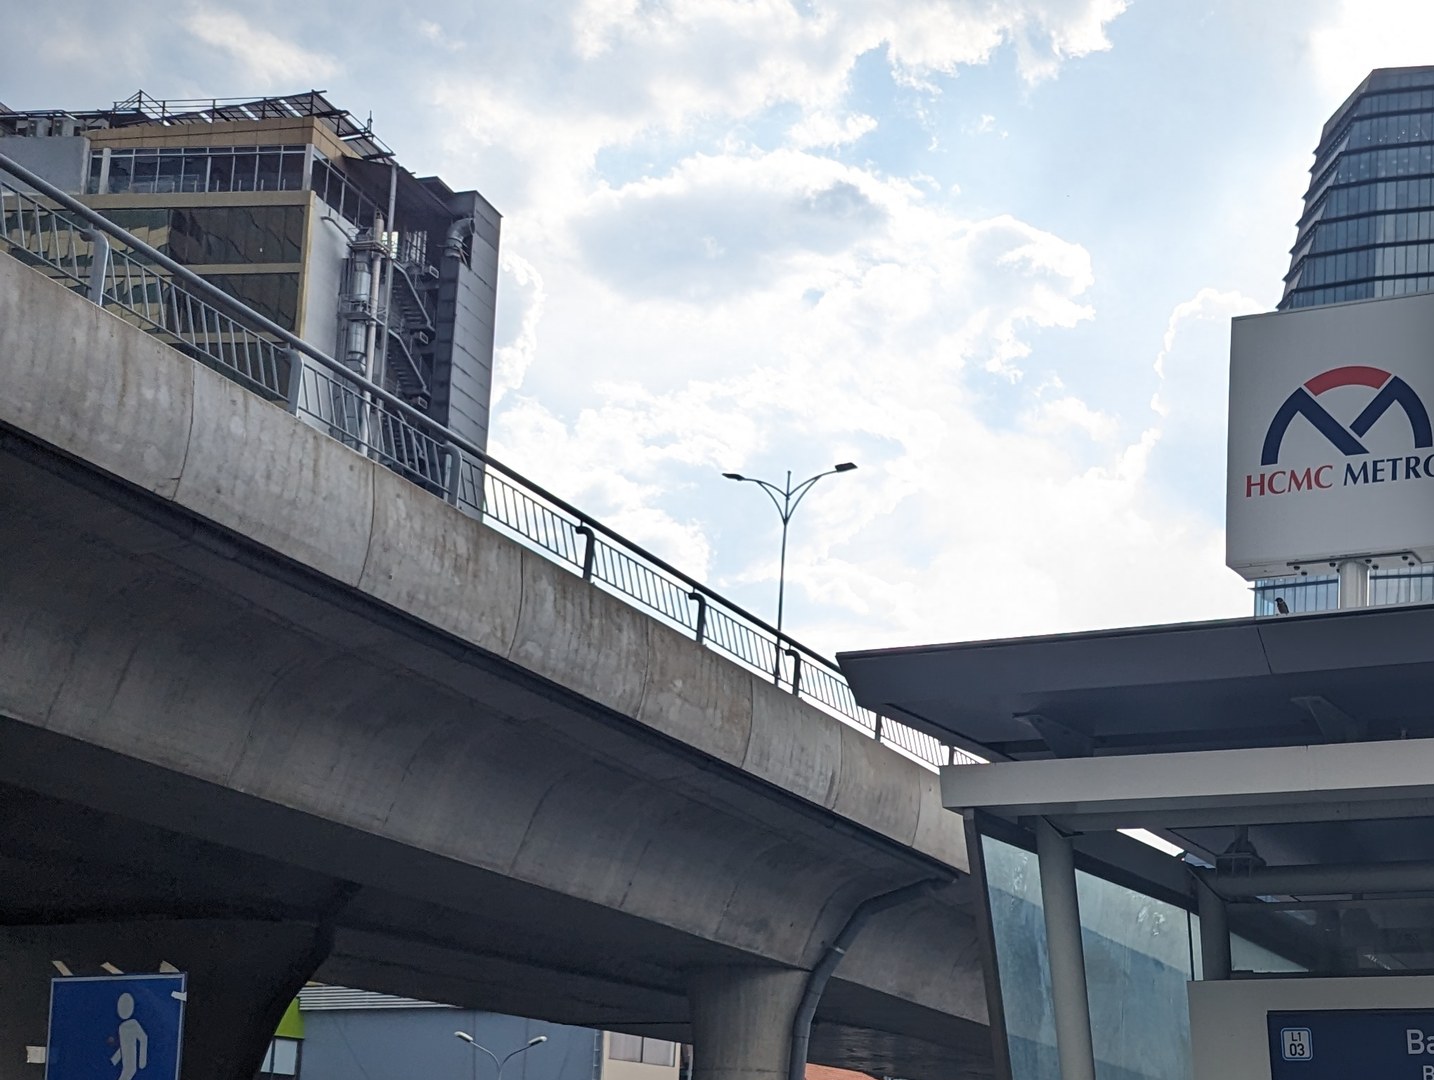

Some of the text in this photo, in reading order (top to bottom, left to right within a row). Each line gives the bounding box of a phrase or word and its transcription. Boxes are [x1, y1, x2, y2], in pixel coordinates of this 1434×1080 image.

[1245, 465, 1333, 498] HCMC
[1291, 1031, 1302, 1042] L1
[1289, 1043, 1305, 1057] 03
